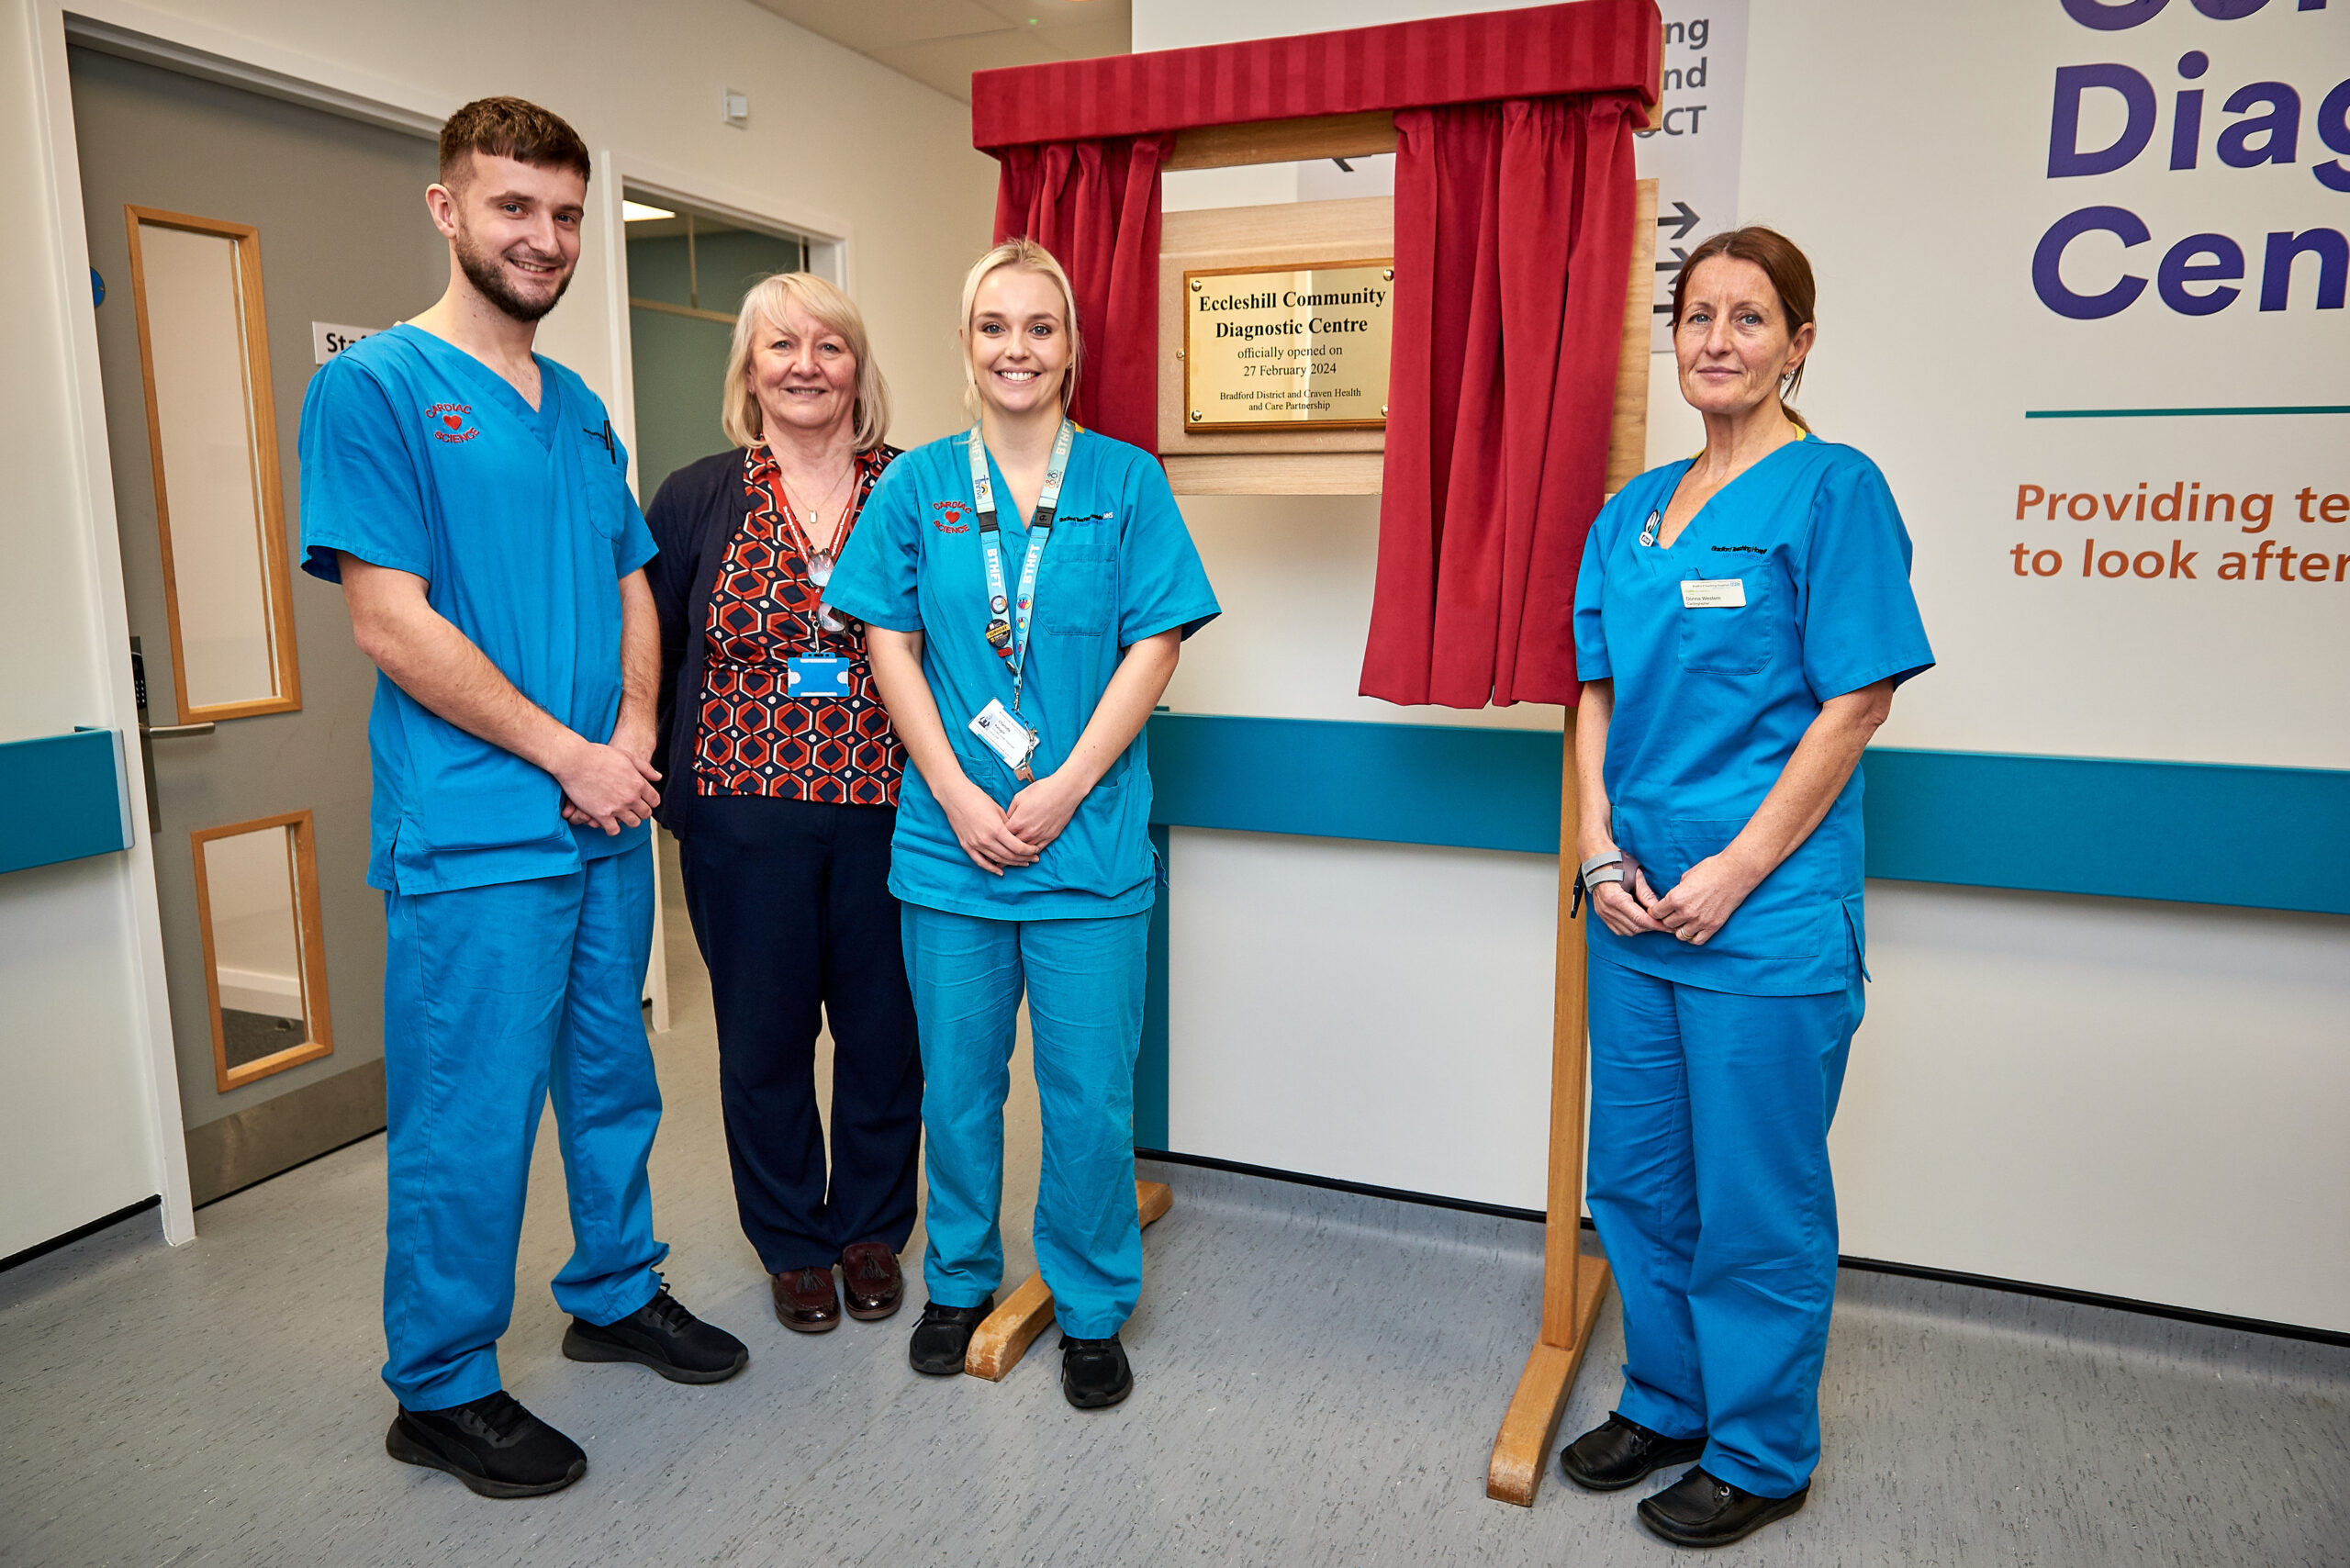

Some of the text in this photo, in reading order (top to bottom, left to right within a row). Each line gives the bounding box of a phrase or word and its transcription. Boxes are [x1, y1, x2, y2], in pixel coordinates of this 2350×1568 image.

[1633, 105, 1707, 138] CT
[2031, 205, 2350, 320] Cen
[1199, 286, 1387, 312] Eccleshill Community
[1215, 317, 1368, 342] Diagnostic Centre
[325, 331, 367, 353] St
[1237, 345, 1343, 361] officially opened on
[1243, 363, 1337, 379] 27 February 2024
[1220, 387, 1361, 400] Bradford District and Craven Health
[425, 402, 473, 419] CARDIAC
[1248, 400, 1331, 411] and Care Partnership
[433, 426, 480, 444] SCIENCE
[1056, 420, 1071, 456] BTHFT
[933, 500, 972, 515] CARDIAC
[2015, 481, 2350, 534] Providing te
[933, 519, 970, 534] SCIENCE
[987, 548, 1002, 588] BTHFT
[1022, 543, 1040, 584] BTHFT
[2009, 538, 2350, 582] to look after
